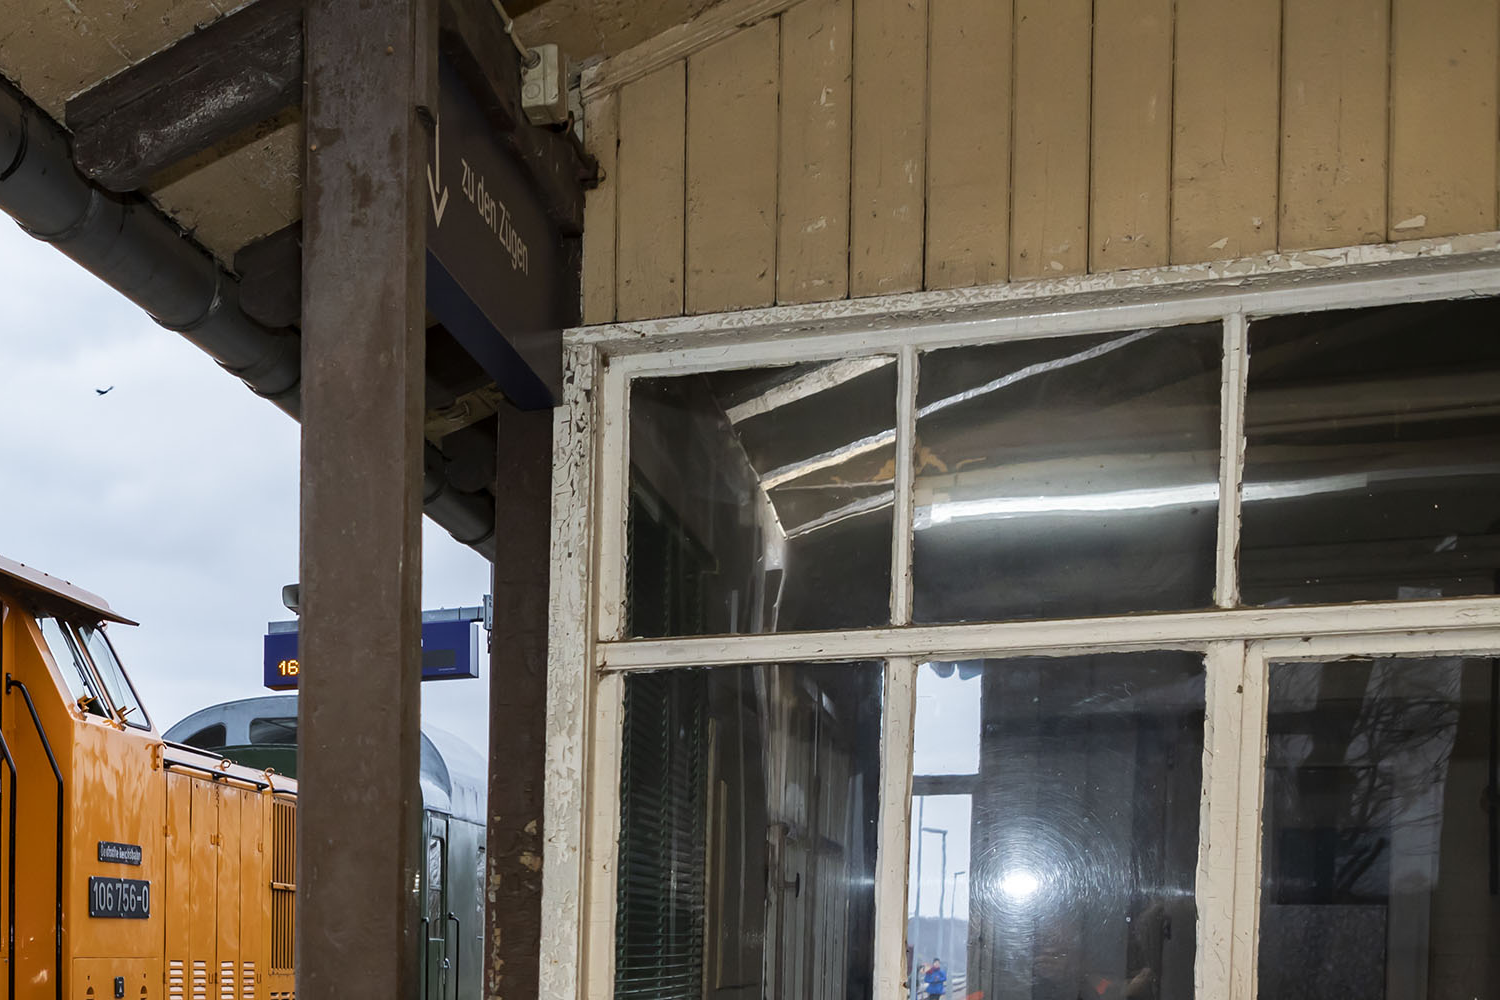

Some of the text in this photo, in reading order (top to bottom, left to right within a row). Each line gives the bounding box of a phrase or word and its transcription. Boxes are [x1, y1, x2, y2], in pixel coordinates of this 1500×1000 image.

[461, 158, 529, 277] zu den Zügen
[93, 881, 149, 913] 106 756-0
